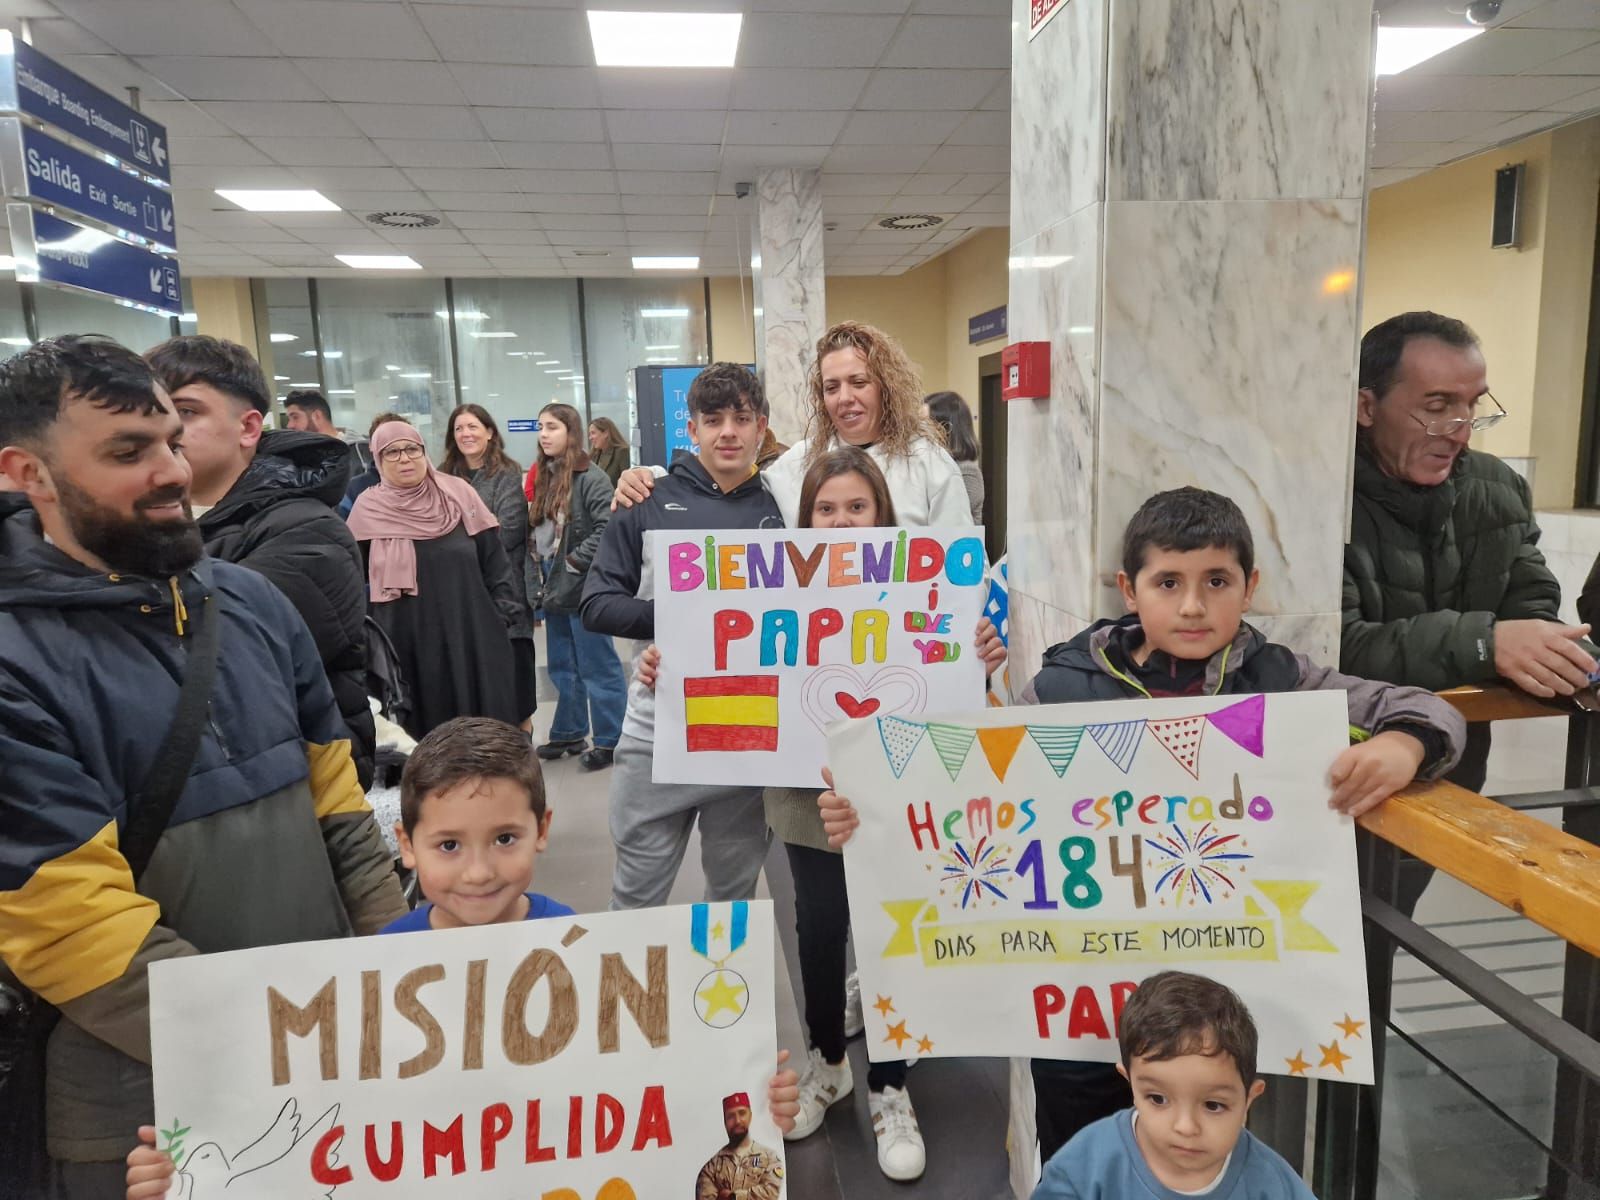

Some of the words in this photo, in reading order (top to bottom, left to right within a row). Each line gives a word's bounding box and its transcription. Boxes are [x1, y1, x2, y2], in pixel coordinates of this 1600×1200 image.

[28, 148, 82, 194] Salida
[88, 184, 107, 205] Exit
[112, 195, 137, 217] Sortie
[714, 591, 889, 671] PAPÁ
[904, 611, 953, 634] LOVE
[913, 639, 961, 664] YOU
[907, 796, 1037, 851] Hemos
[1072, 773, 1274, 830] esperado
[1015, 834, 1147, 910] 184
[935, 927, 976, 960] DIAS
[1002, 930, 1057, 954] PARA
[1081, 930, 1142, 954] ESTE
[1163, 925, 1266, 952] MOMENTO
[267, 924, 671, 1087] MISIÓN
[310, 1085, 672, 1186] CUMPLIDA
